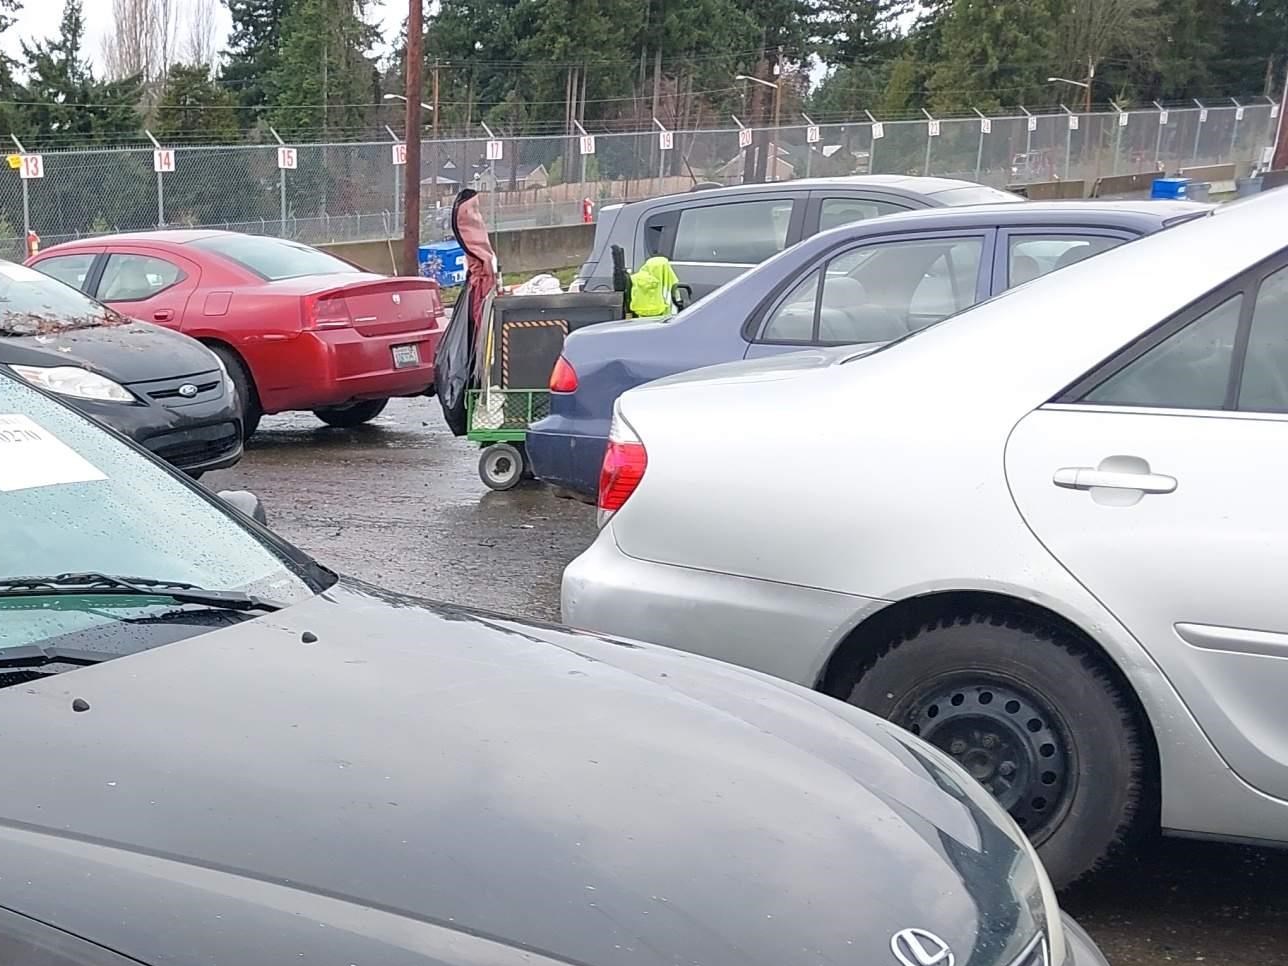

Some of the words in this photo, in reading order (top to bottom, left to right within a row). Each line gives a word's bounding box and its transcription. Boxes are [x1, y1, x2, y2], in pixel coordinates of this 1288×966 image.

[662, 133, 671, 148] 19
[741, 130, 751, 145] 20
[809, 127, 817, 141] 21
[491, 142, 499, 158] 17
[583, 137, 593, 153] 18
[158, 151, 171, 170] 14
[282, 149, 294, 167] 15
[396, 146, 408, 162] 16
[24, 156, 40, 177] 13
